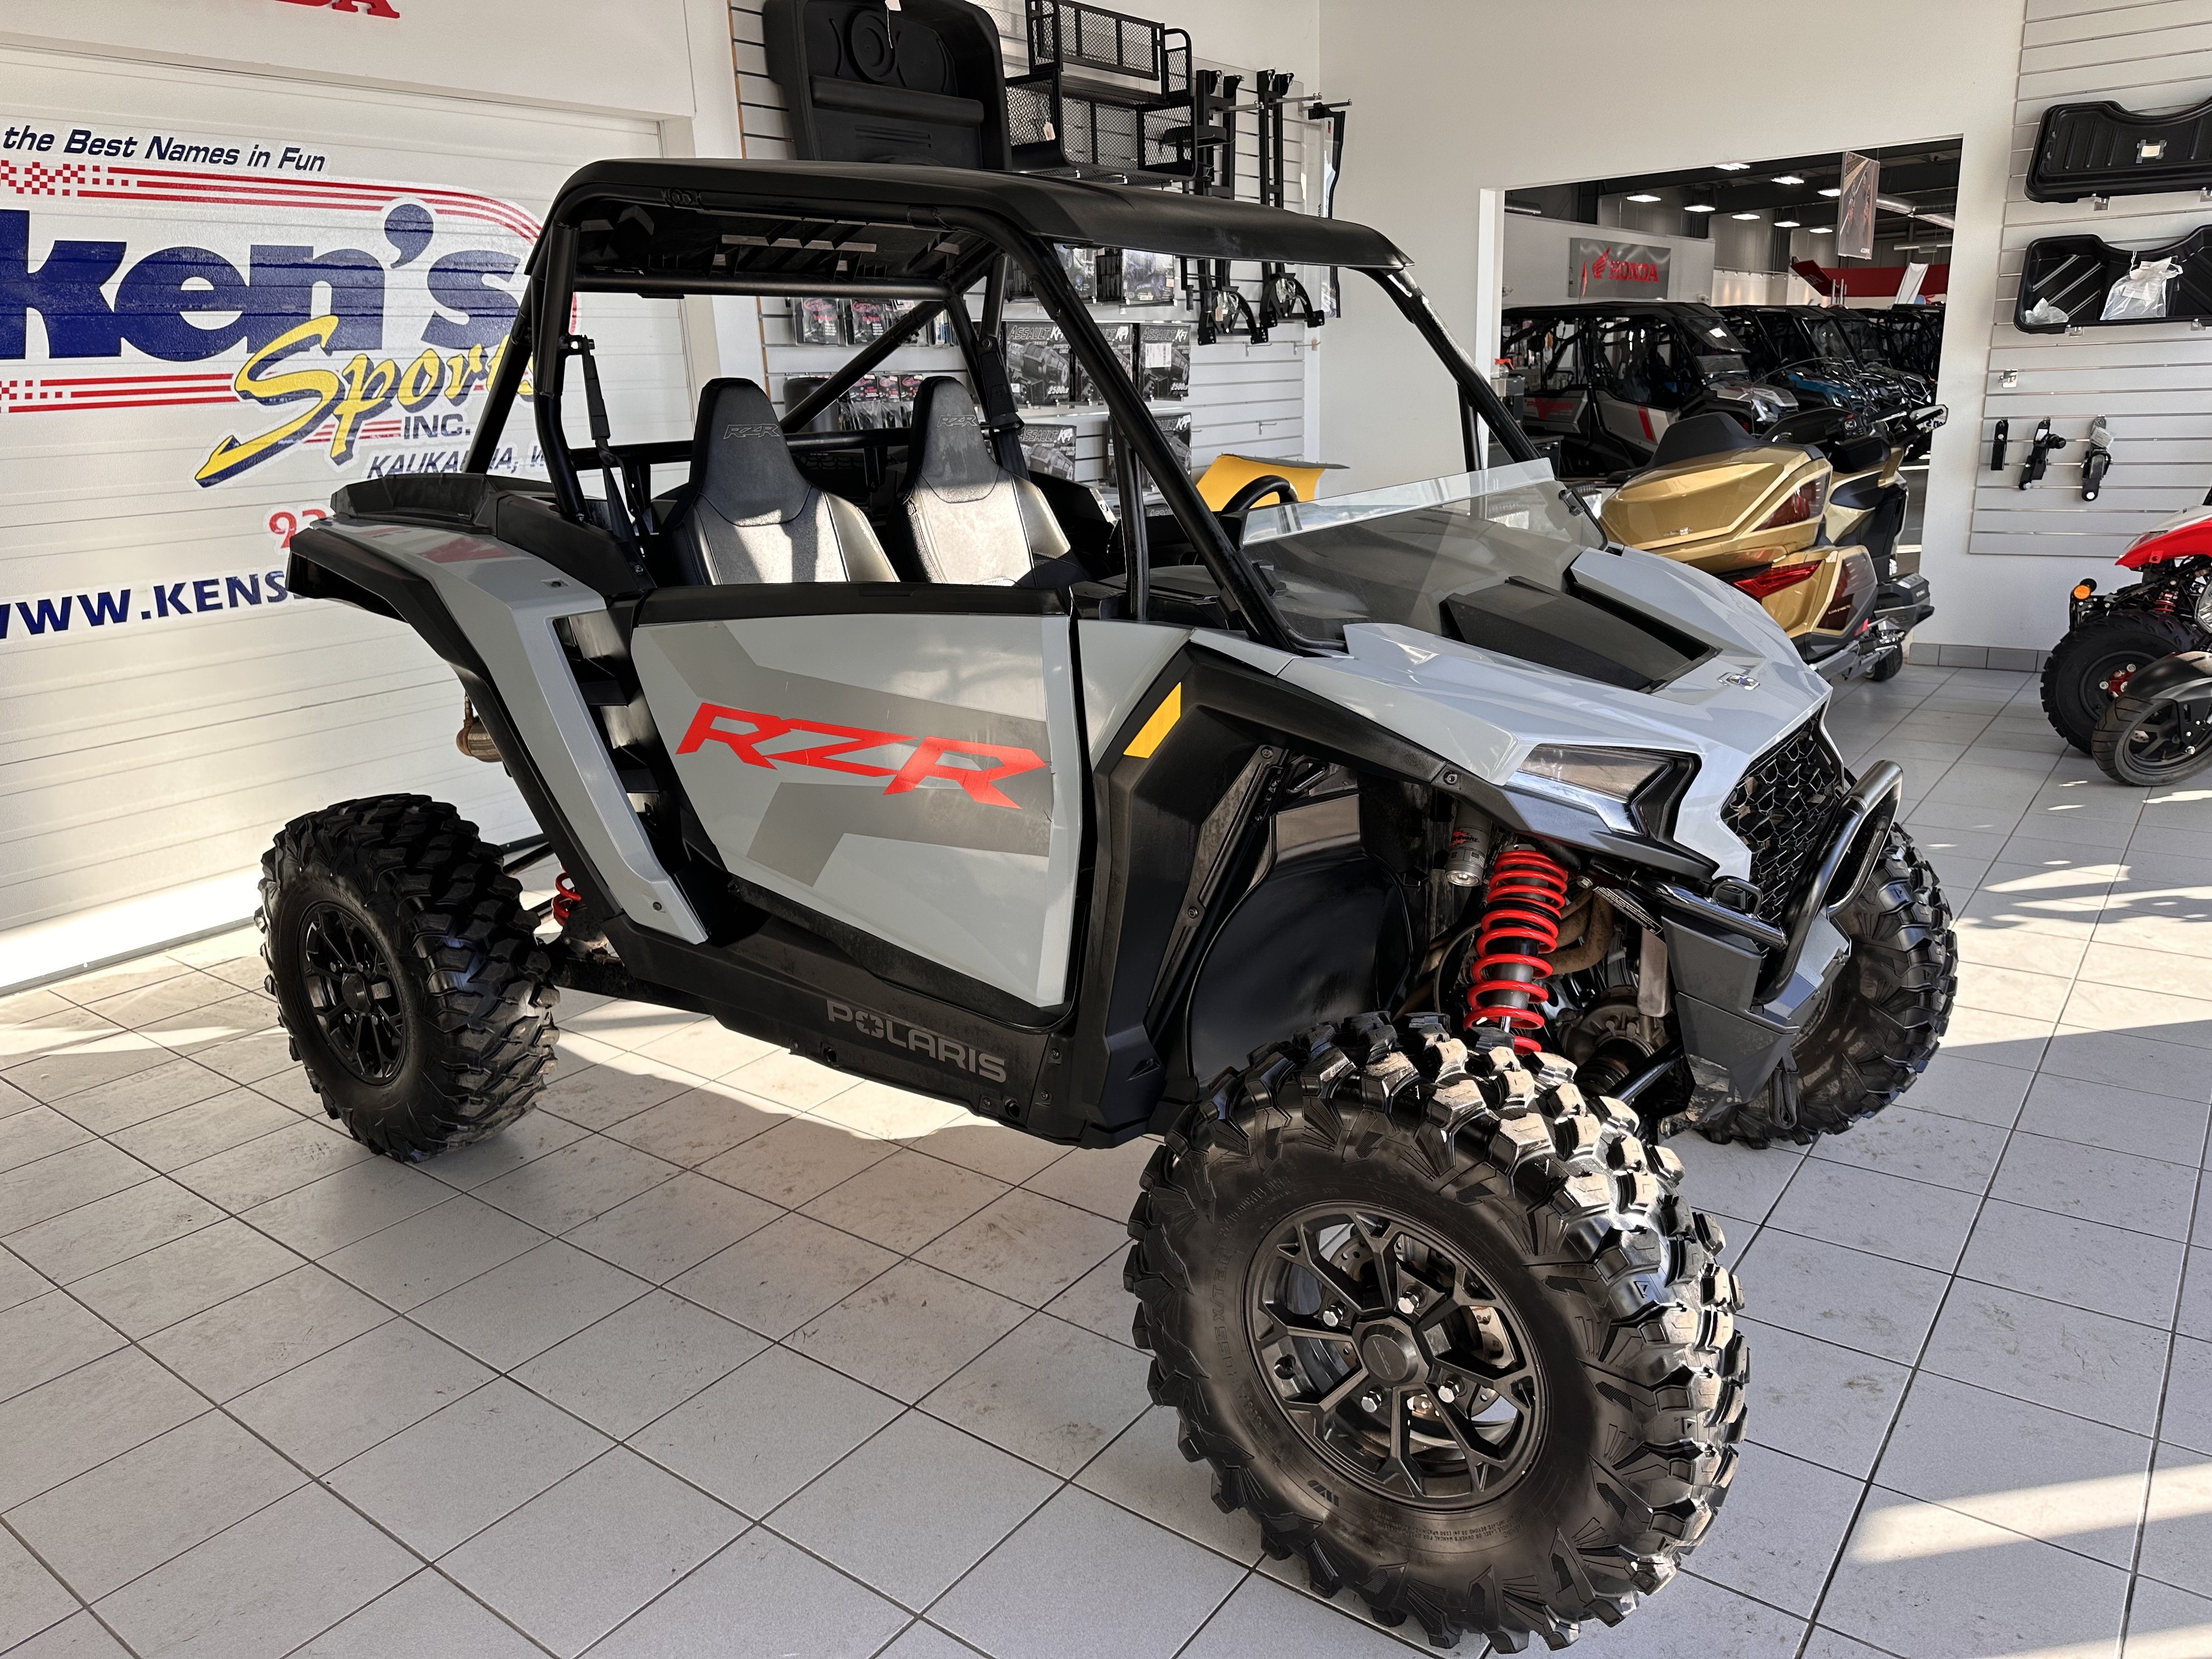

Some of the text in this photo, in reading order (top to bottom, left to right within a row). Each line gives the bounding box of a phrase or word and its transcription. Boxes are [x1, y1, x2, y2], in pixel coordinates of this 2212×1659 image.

[3, 125, 325, 172] the Best Names in Fun
[0, 204, 521, 362] ken's
[1609, 261, 1658, 283] HONDA
[1007, 325, 1051, 340] ASSAULT
[1141, 328, 1176, 341] ASSAULT
[195, 315, 535, 487] Spor
[404, 414, 471, 439] INC.
[723, 424, 780, 439] RZR
[937, 414, 978, 427] RZR
[1018, 427, 1059, 442] ASSAULT
[366, 448, 520, 479] KAUKAA,
[0, 570, 306, 639] WW.KENS
[675, 702, 1047, 810] RZR
[826, 1000, 1007, 1083] POLARIS
